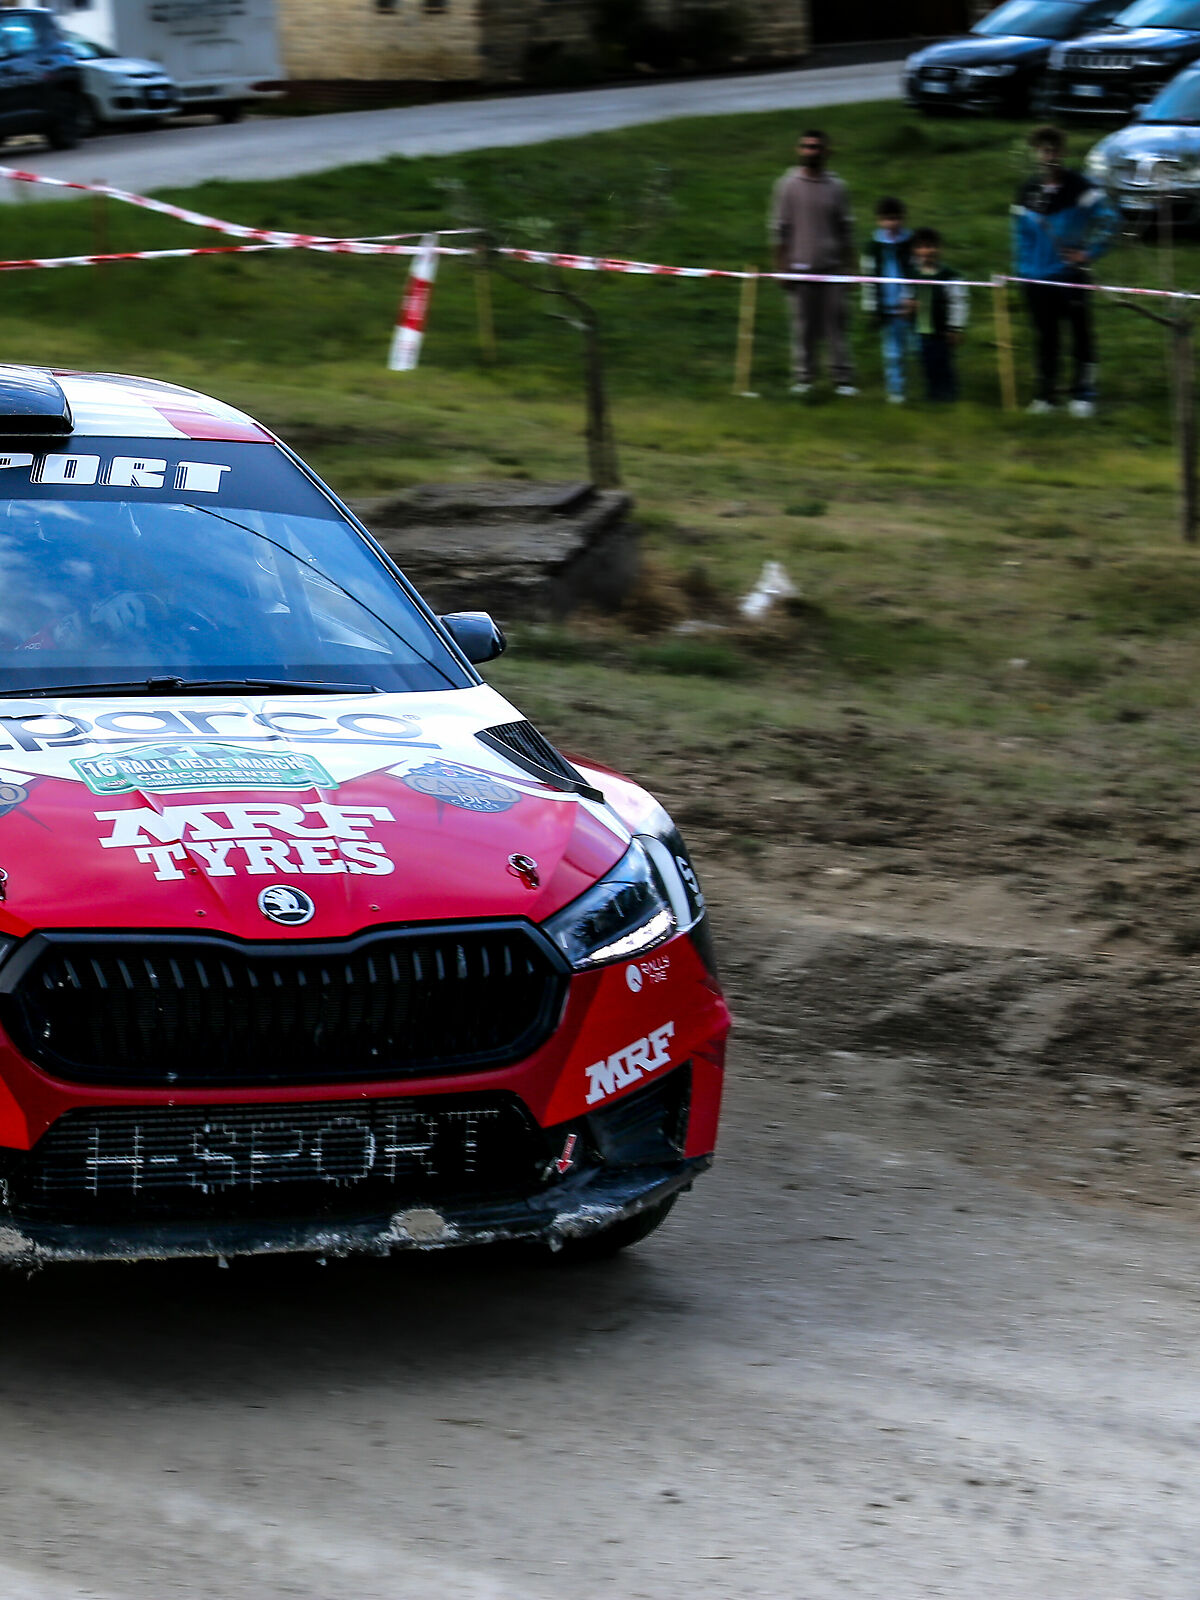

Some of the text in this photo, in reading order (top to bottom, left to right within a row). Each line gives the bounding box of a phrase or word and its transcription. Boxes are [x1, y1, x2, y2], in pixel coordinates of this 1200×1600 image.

[116, 758, 175, 775] RALLY
[177, 755, 237, 770] DELLE
[136, 770, 282, 782] CONCORRENTE
[414, 777, 513, 800] CAFFO
[93, 802, 398, 849] MRF
[133, 838, 396, 882] TYRES
[585, 1020, 675, 1105] MRF
